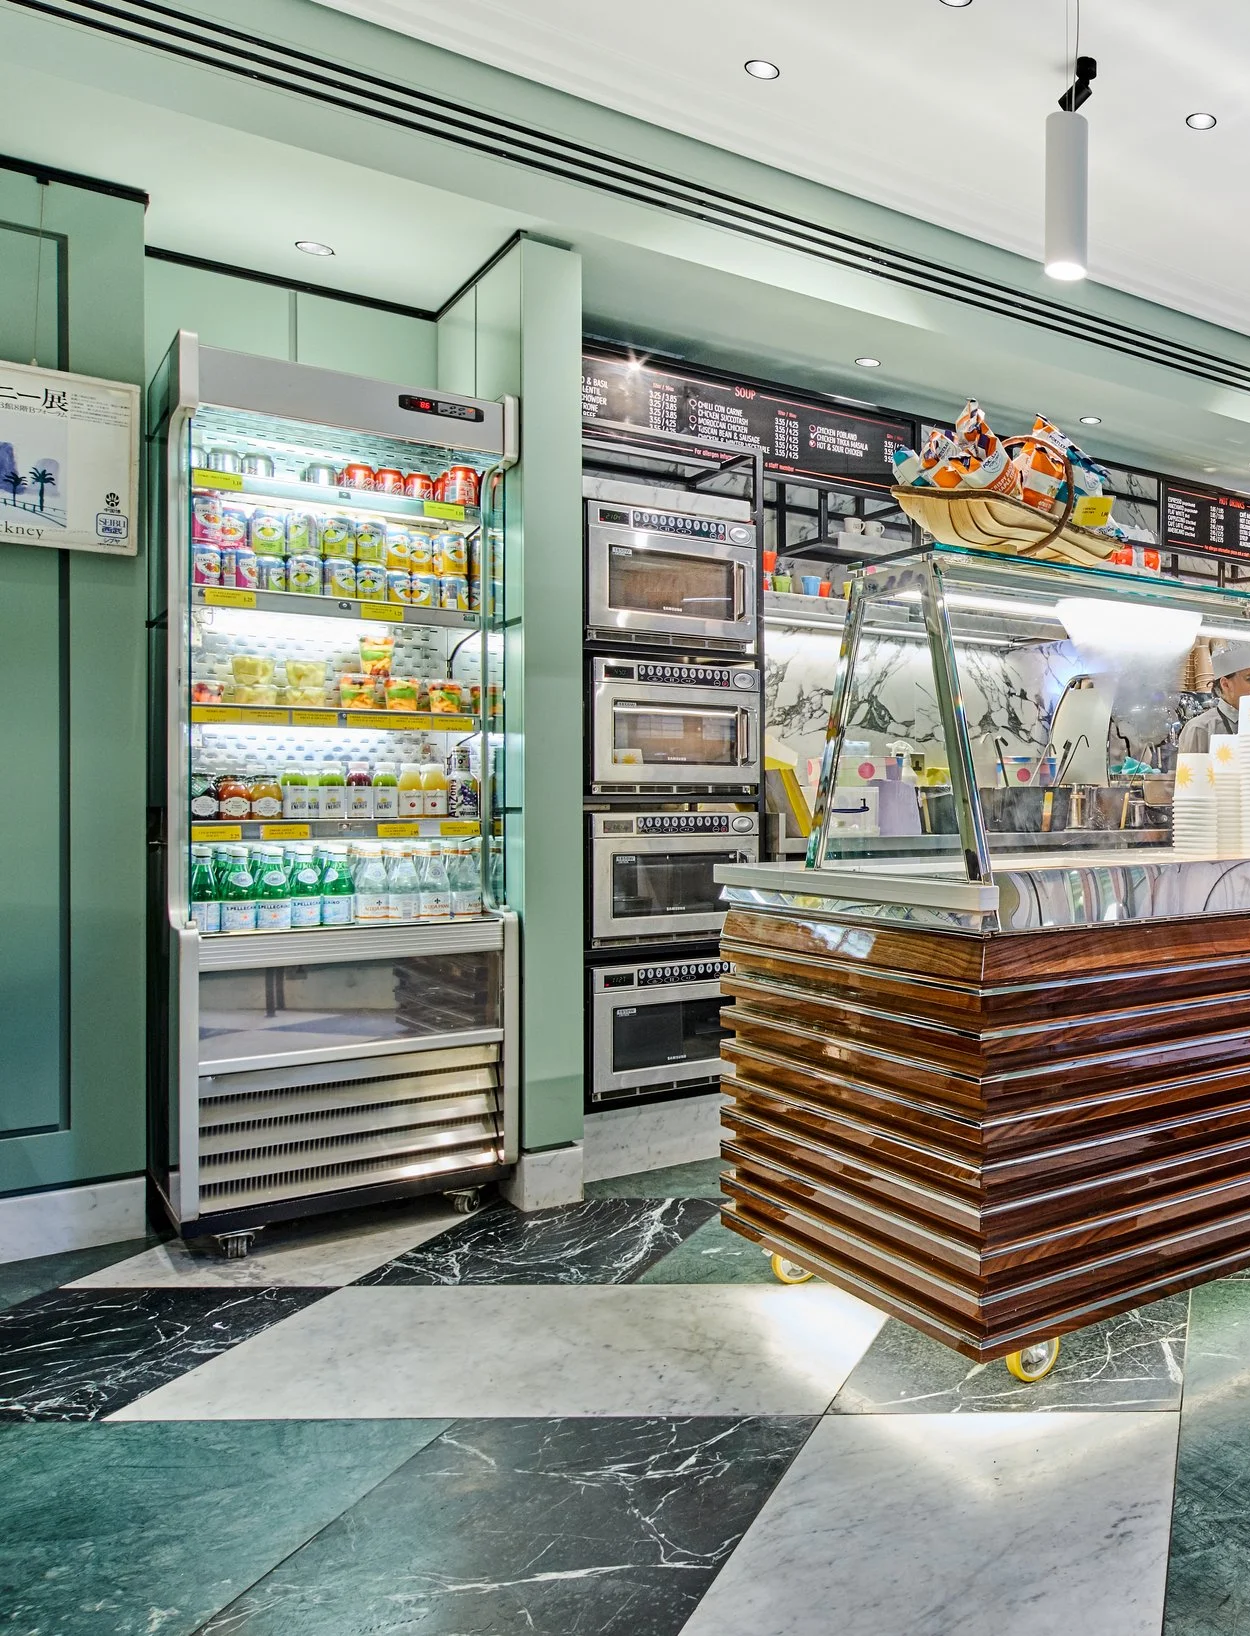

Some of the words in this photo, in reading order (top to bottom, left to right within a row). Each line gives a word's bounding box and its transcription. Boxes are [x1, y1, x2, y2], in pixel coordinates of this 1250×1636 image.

[582, 386, 601, 395] LENTIL
[593, 378, 608, 389] BASIL
[735, 386, 756, 400] SOUP
[698, 401, 713, 410] CHILLI
[714, 405, 725, 413] CON
[726, 407, 743, 417] CARNE
[698, 409, 719, 420] CHICKEN
[721, 414, 748, 426] SUCCOTASH
[698, 418, 726, 429] MOROCCAN
[728, 424, 748, 434] CHICKEN
[817, 426, 835, 436] CHICKEN
[837, 430, 857, 441] POBLANO
[719, 430, 732, 438] BEAN
[739, 434, 760, 444] SAUSAGE
[817, 434, 835, 444] CHICKEN
[837, 438, 850, 447] TIKKA
[851, 440, 868, 451] MASALA
[817, 442, 826, 450] HOT
[845, 448, 863, 457] CHICKEN
[99, 518, 126, 528] SEIBU
